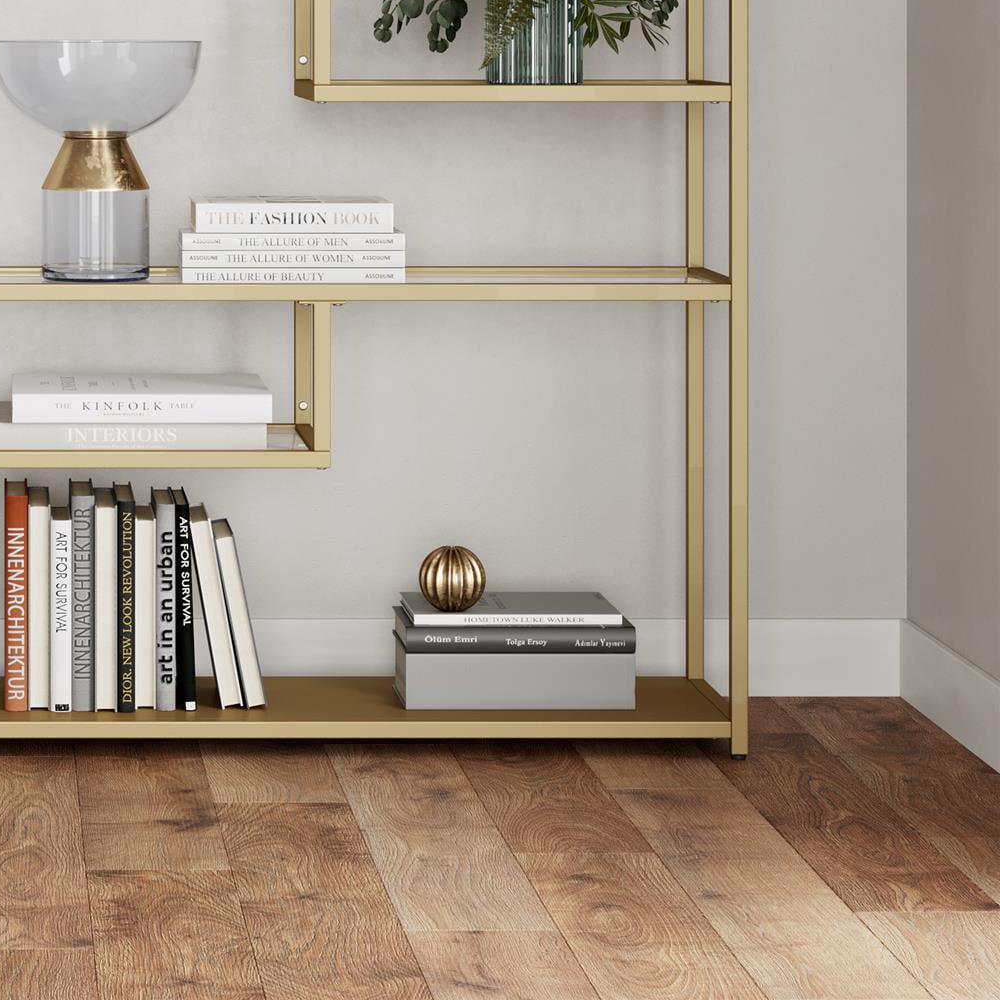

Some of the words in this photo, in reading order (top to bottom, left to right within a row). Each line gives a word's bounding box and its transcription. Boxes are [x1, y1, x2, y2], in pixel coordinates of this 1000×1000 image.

[250, 211, 328, 225] FASHION
[333, 211, 380, 225] BOOK
[239, 238, 259, 246] THE
[262, 238, 304, 246] ALLURE
[307, 238, 321, 246] OF
[324, 238, 348, 246] MEN
[227, 254, 247, 263] THE
[251, 254, 293, 263] ALLURE
[295, 254, 309, 263] OF
[312, 254, 354, 263] WOMEN
[195, 272, 216, 281] THE
[219, 272, 260, 281] ALLURE
[263, 272, 278, 281] OF
[281, 272, 324, 281] BEAUTY
[82, 401, 162, 410] KINFOLK
[67, 427, 177, 442] INTERIORS
[179, 516, 189, 539] ART
[55, 532, 68, 554] ART
[122, 512, 132, 593] REVOLUTION
[158, 531, 172, 593] urban
[180, 543, 190, 568] FOR
[55, 557, 68, 579] FOR
[74, 508, 91, 680] INNENARCHITEKTUR
[181, 571, 191, 626] SURVIVAL
[7, 527, 24, 700] INNENARCHITEKTUR
[55, 582, 68, 633] SURVIVAL
[122, 596, 132, 634] LOOK
[161, 598, 172, 623] an
[122, 636, 132, 665] NEW
[158, 629, 172, 648] in
[454, 634, 478, 643] Emri
[505, 638, 526, 646] Tolga
[159, 655, 172, 684] art
[122, 668, 132, 703] DIOR.
